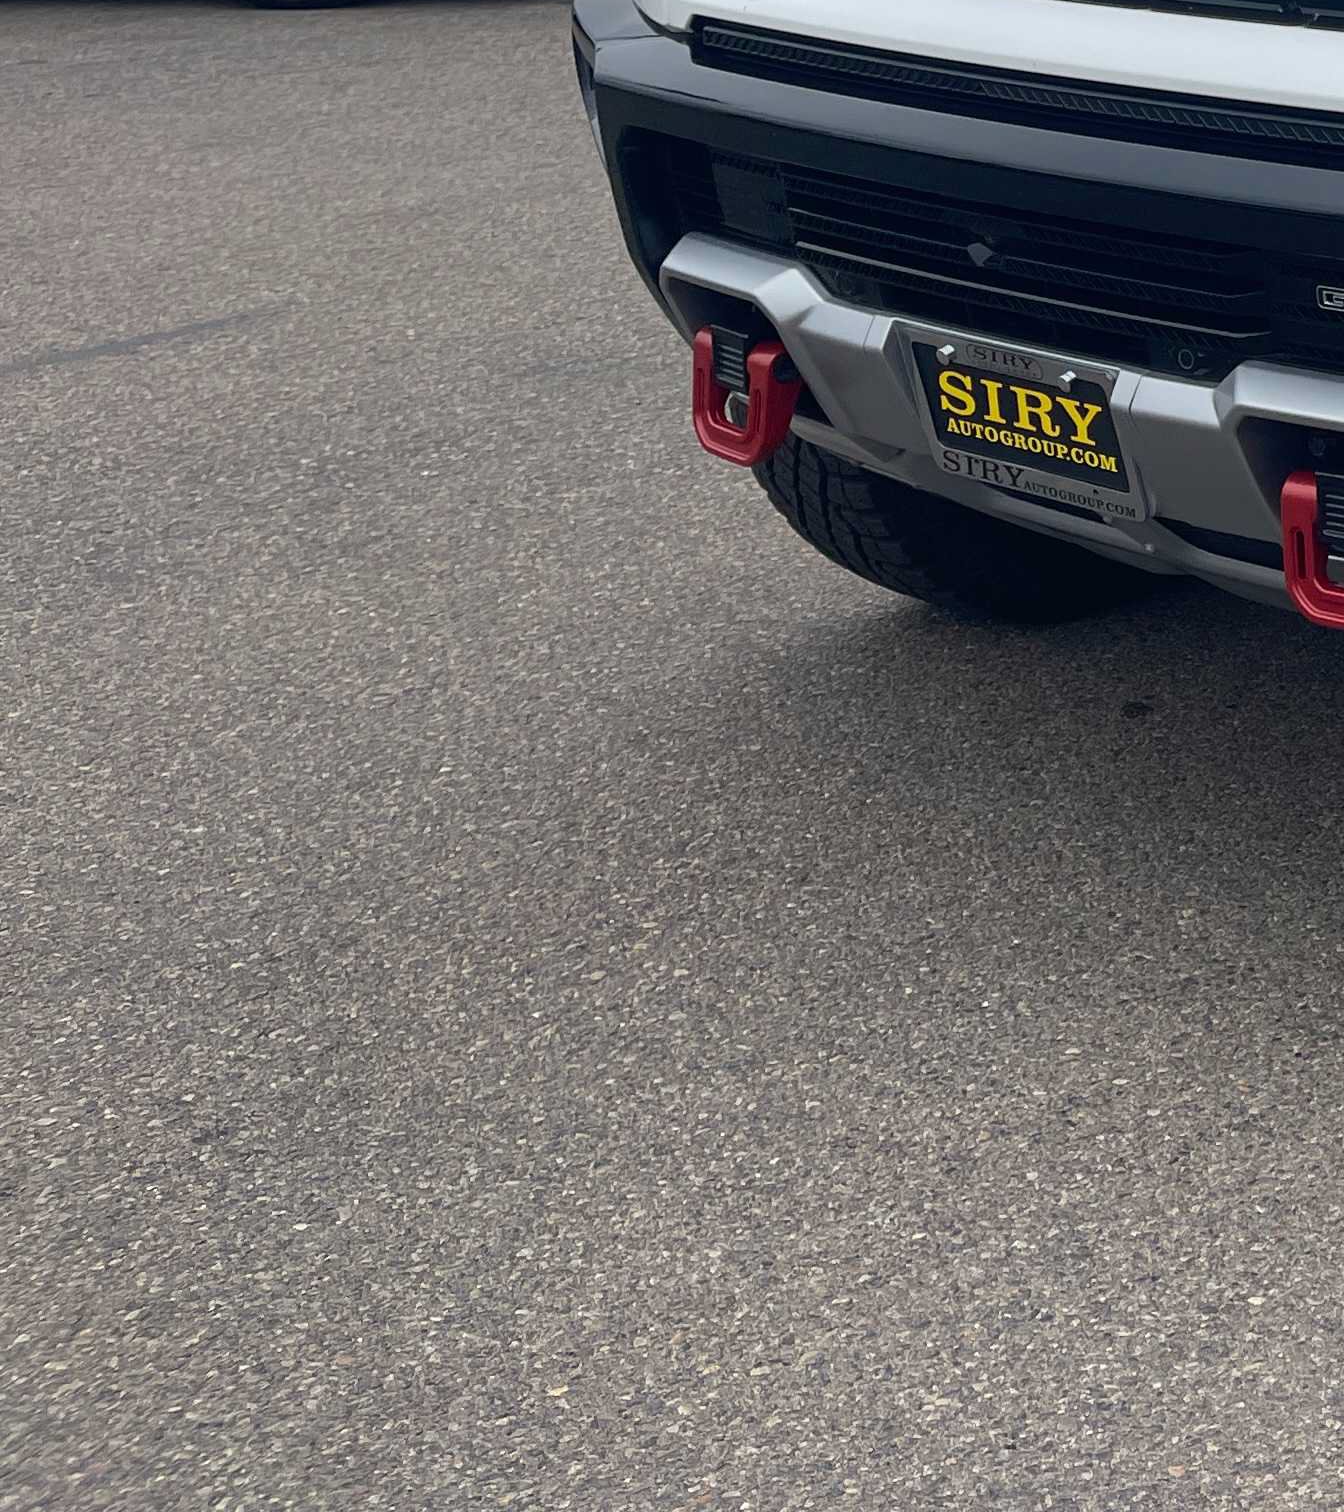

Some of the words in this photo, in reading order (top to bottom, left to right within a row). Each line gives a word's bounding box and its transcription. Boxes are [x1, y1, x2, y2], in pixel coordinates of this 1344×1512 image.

[971, 345, 1035, 370] SIRY
[938, 370, 1102, 446] SIRY
[947, 417, 1119, 473] AUTOGROUP.COM
[943, 449, 1025, 489] SIRY
[1024, 479, 1137, 519] AUTOGROUP.COM
